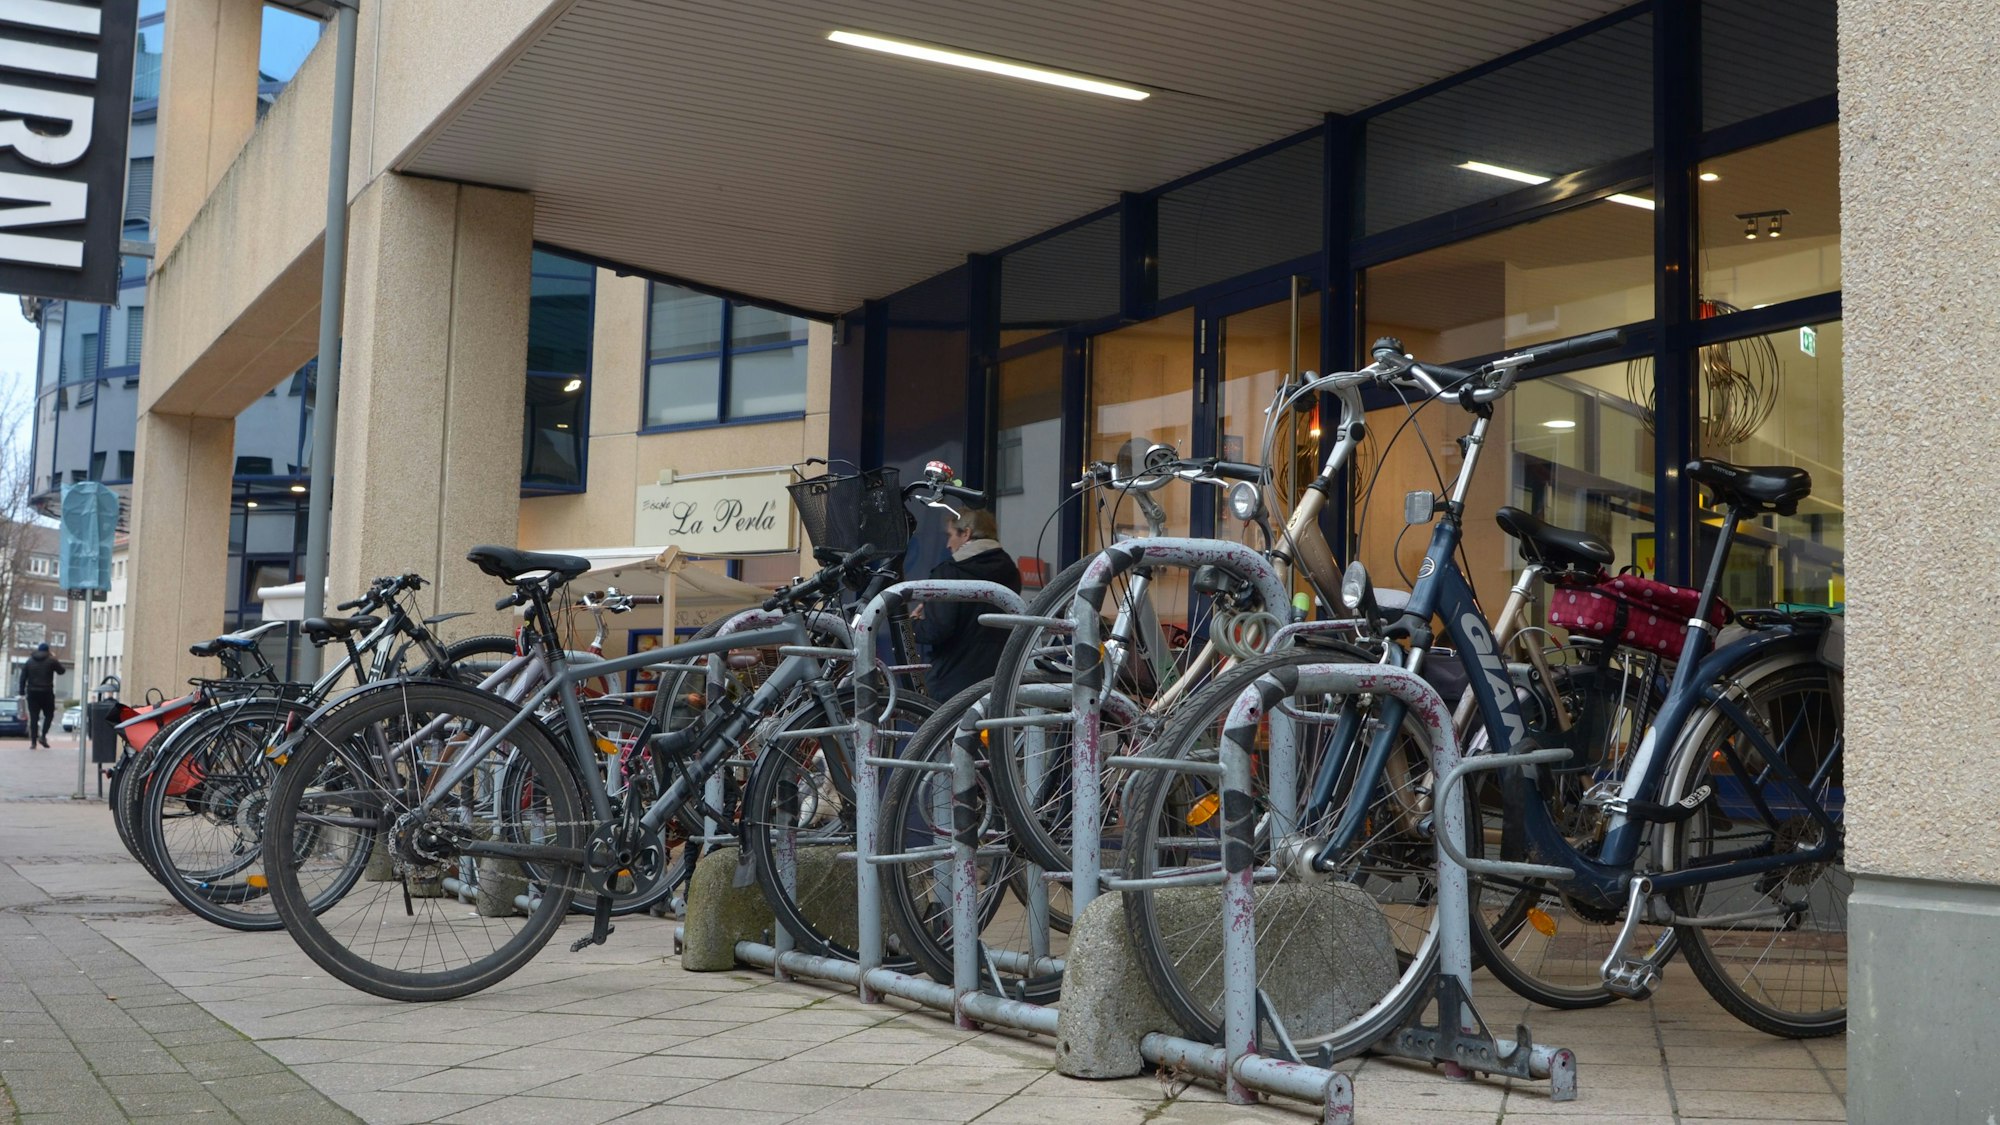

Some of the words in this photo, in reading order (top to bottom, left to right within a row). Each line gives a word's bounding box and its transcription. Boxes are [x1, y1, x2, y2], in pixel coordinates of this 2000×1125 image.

[669, 501, 704, 535] La
[713, 498, 776, 533] Perla
[1460, 612, 1537, 779] GIAN
[830, 700, 856, 772] FOUS
